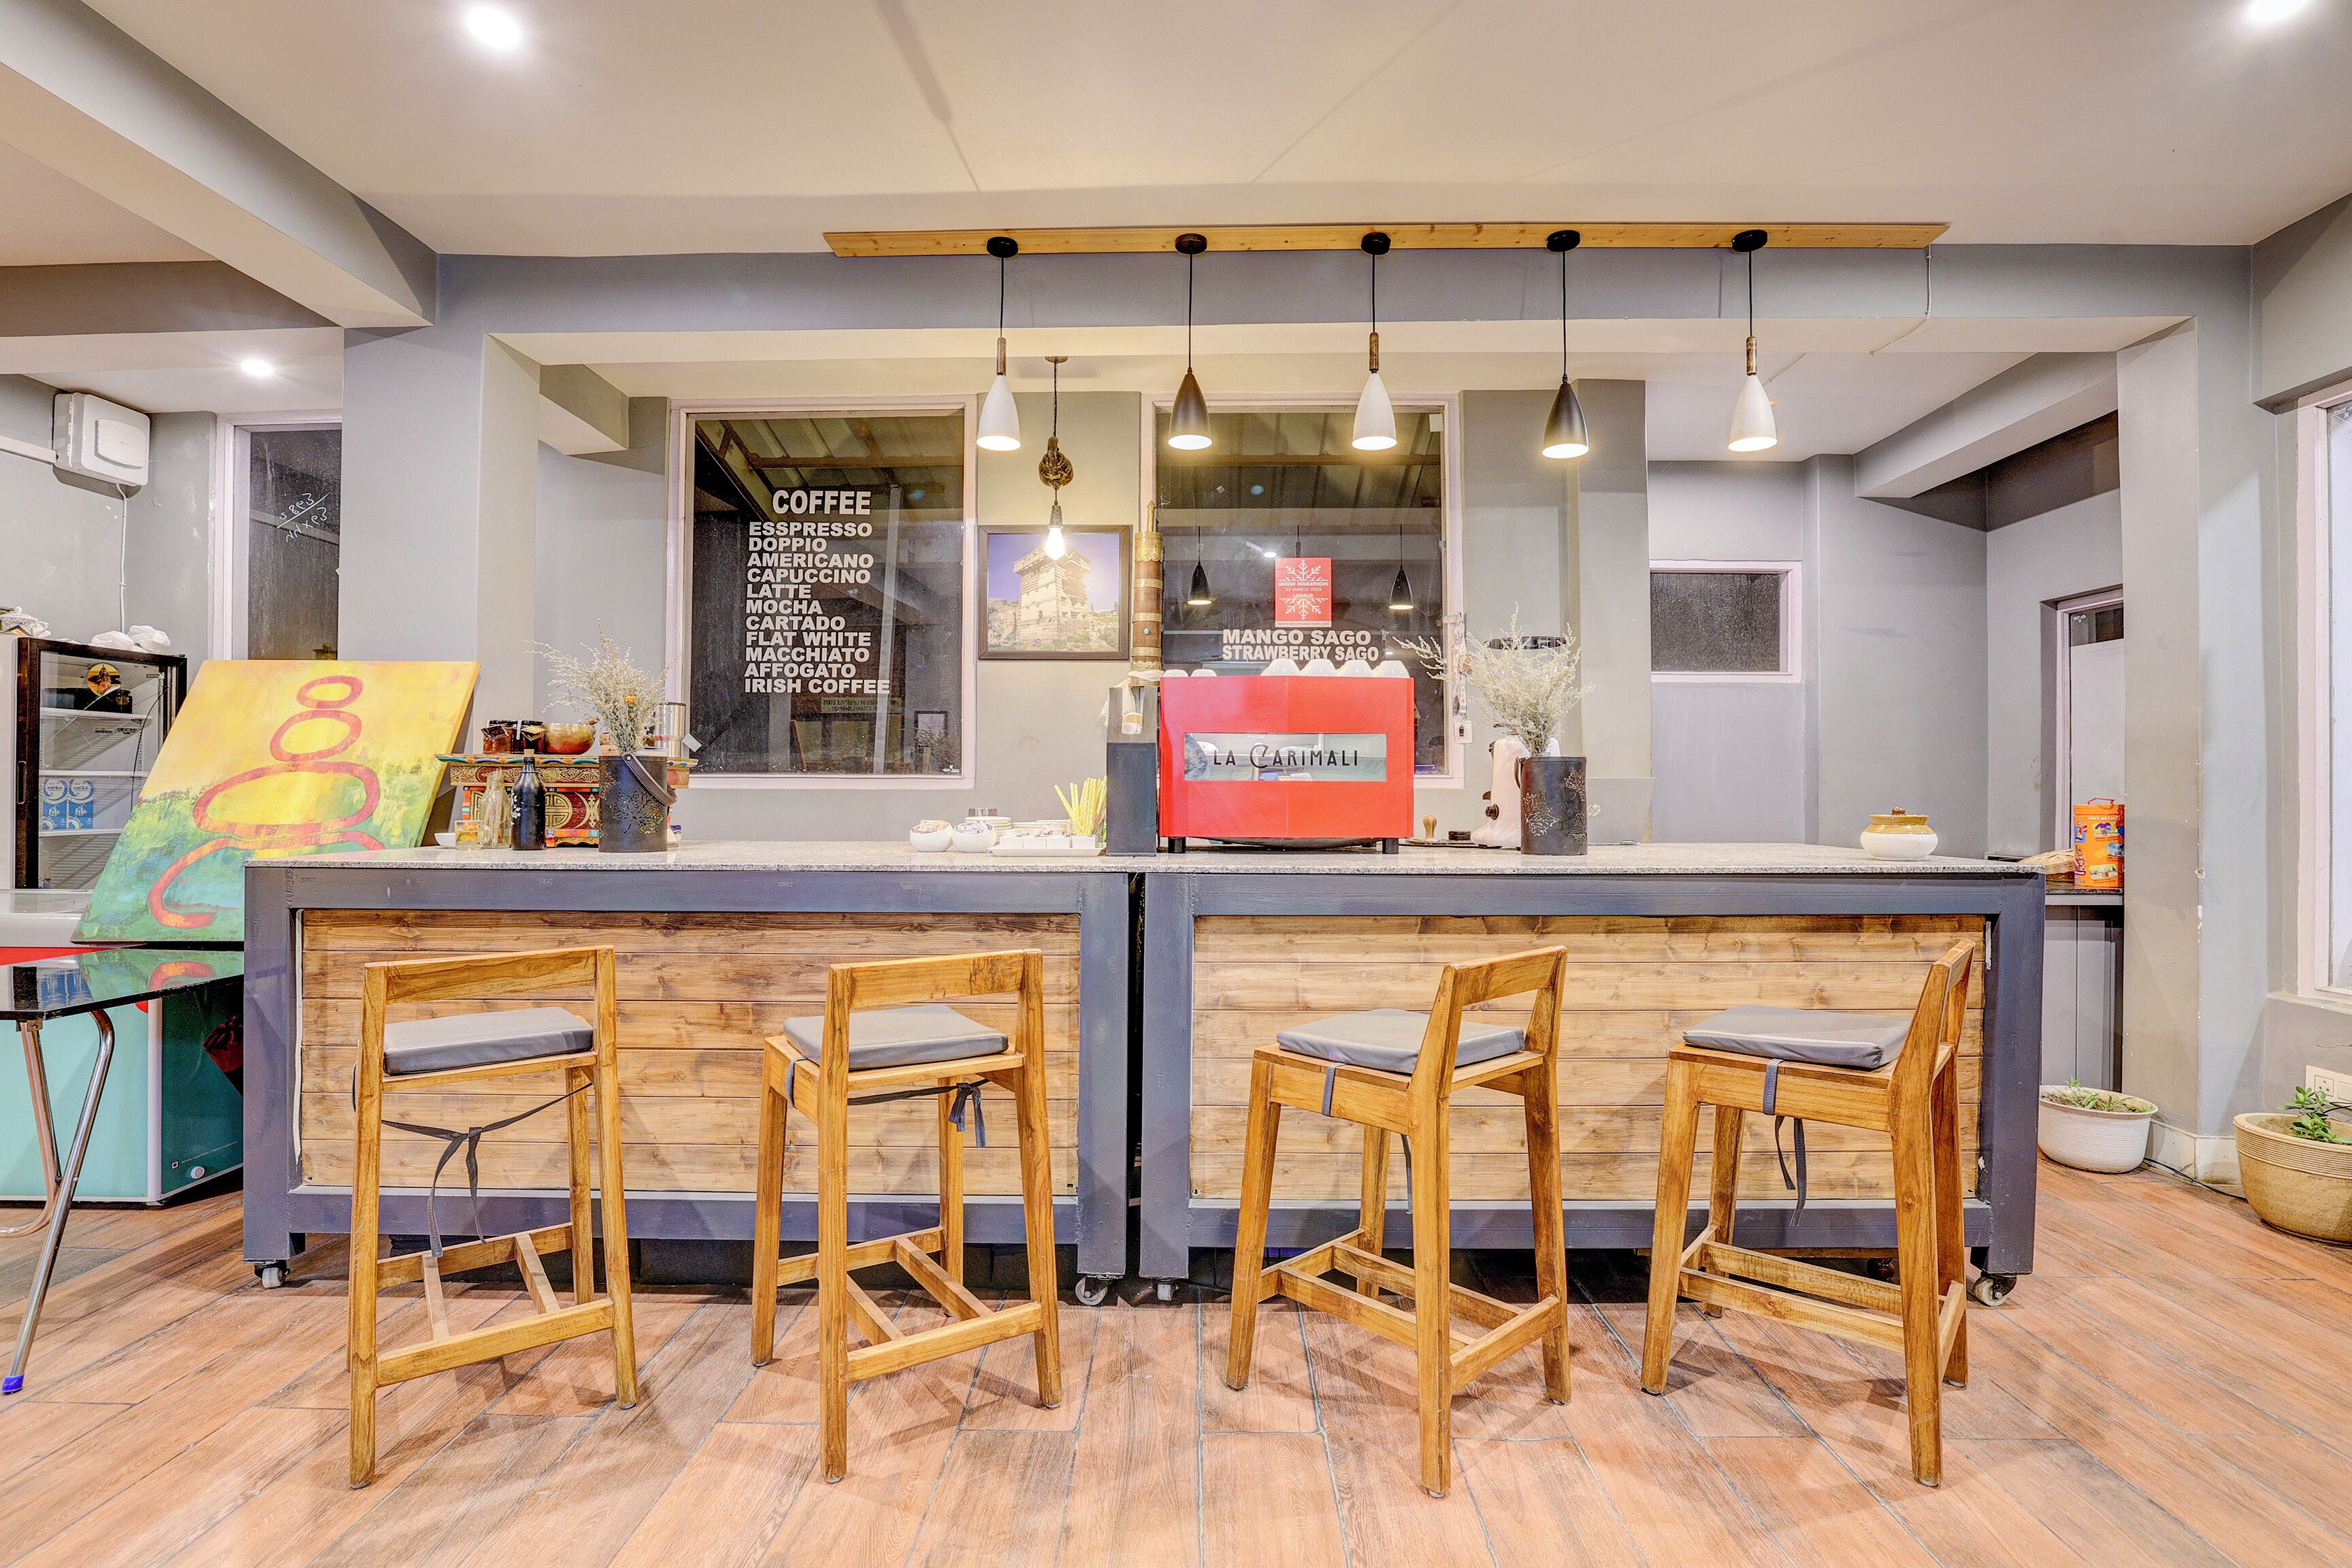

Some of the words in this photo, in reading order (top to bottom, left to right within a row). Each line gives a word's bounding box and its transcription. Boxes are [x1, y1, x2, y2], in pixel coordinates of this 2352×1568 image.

[772, 490, 871, 514] COFFEE
[749, 522, 872, 537] ESSPRESSO
[749, 538, 827, 552] DOPPIO
[747, 553, 874, 568] AMERICANO
[747, 569, 870, 584] CAPUCCINO
[747, 585, 811, 598] LATTE
[746, 600, 822, 615] MOCHA
[746, 616, 845, 630] CARTADO
[746, 632, 796, 646] FLAT
[802, 632, 871, 647] WHITE
[1223, 630, 1303, 644] MANGO
[1311, 630, 1371, 645] SAGO
[745, 647, 870, 662] MACCHIATO
[1222, 645, 1331, 660] STRAWBERRY
[1335, 646, 1379, 661] SAGO
[745, 663, 855, 678] AFFOGATO
[745, 679, 801, 693] IRISH
[808, 679, 890, 693] COFFEE
[1213, 750, 1236, 766] LA
